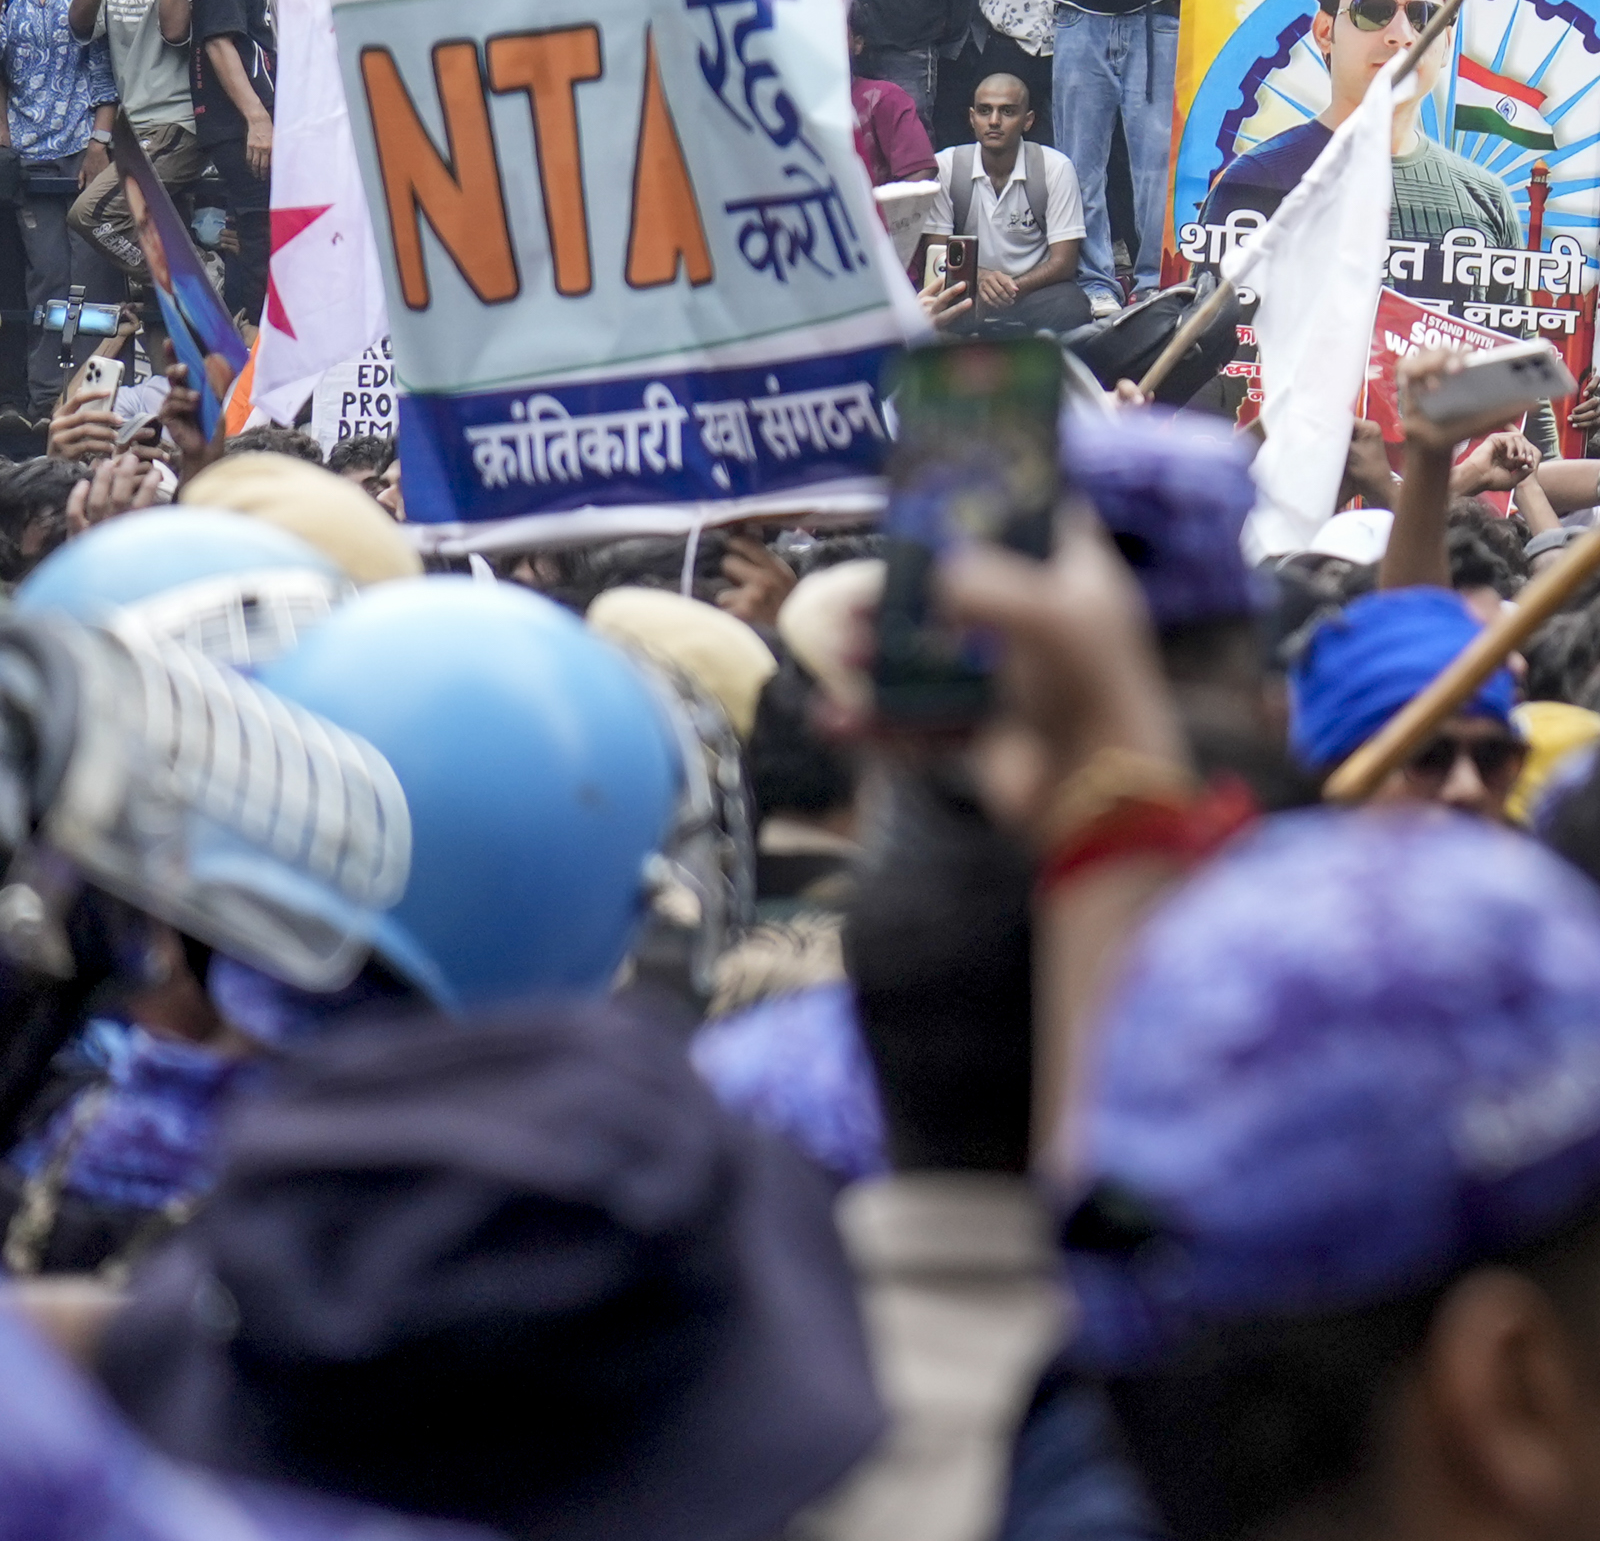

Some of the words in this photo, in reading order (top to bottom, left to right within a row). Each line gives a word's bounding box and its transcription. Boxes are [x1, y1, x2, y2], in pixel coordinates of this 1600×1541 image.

[360, 24, 715, 311] NTA
[1440, 227, 1587, 294] तिवारी
[1428, 316, 1464, 338] STAND
[1465, 329, 1496, 349] WITH
[1462, 300, 1580, 334] नमन
[464, 382, 690, 488] क्रांतिकारी
[749, 373, 882, 458] संगठन
